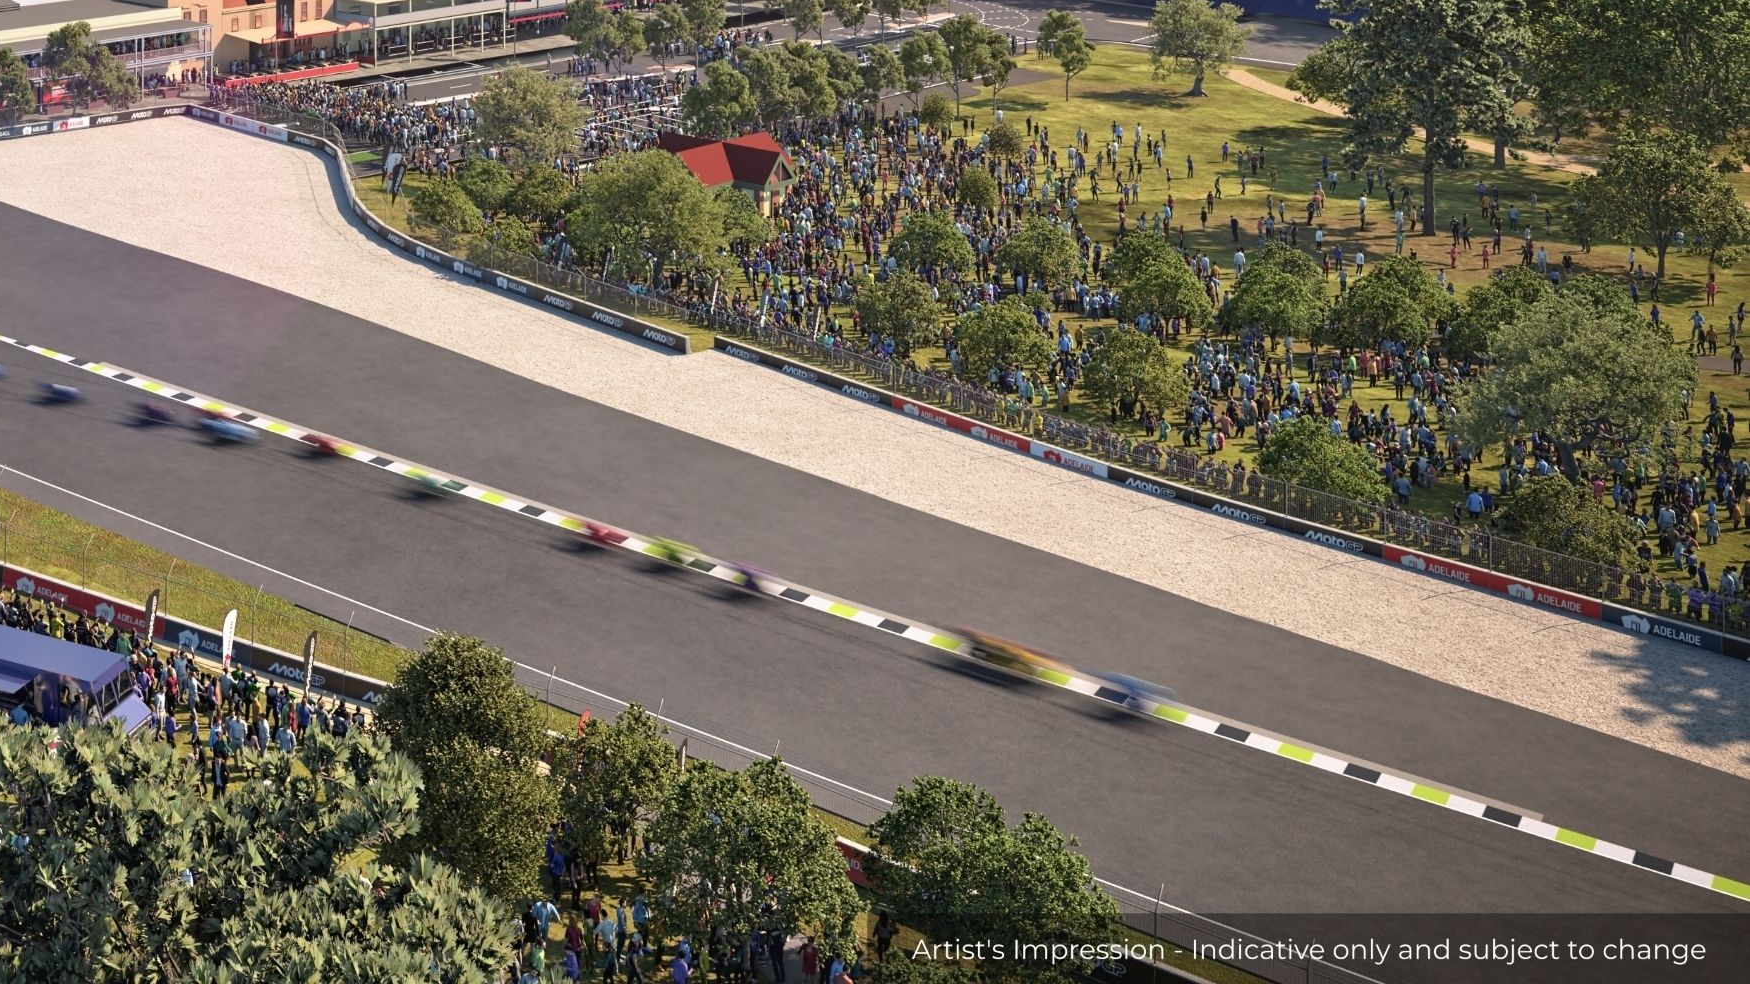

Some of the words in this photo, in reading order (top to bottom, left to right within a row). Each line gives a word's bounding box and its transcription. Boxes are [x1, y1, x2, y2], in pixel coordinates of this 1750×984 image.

[921, 411, 947, 426] ADELAIDE
[989, 433, 1019, 449] ADELAIDE
[1063, 457, 1094, 473] ADELAIDE
[1125, 477, 1176, 498] MotoGP
[1211, 503, 1266, 525] MotoGP
[1305, 530, 1364, 552] MotoGP
[1428, 563, 1470, 583] ADELAIDE
[1536, 593, 1582, 613] ADELAIDE
[117, 613, 146, 629] ADELAID
[1653, 625, 1701, 646] ADELAIDE
